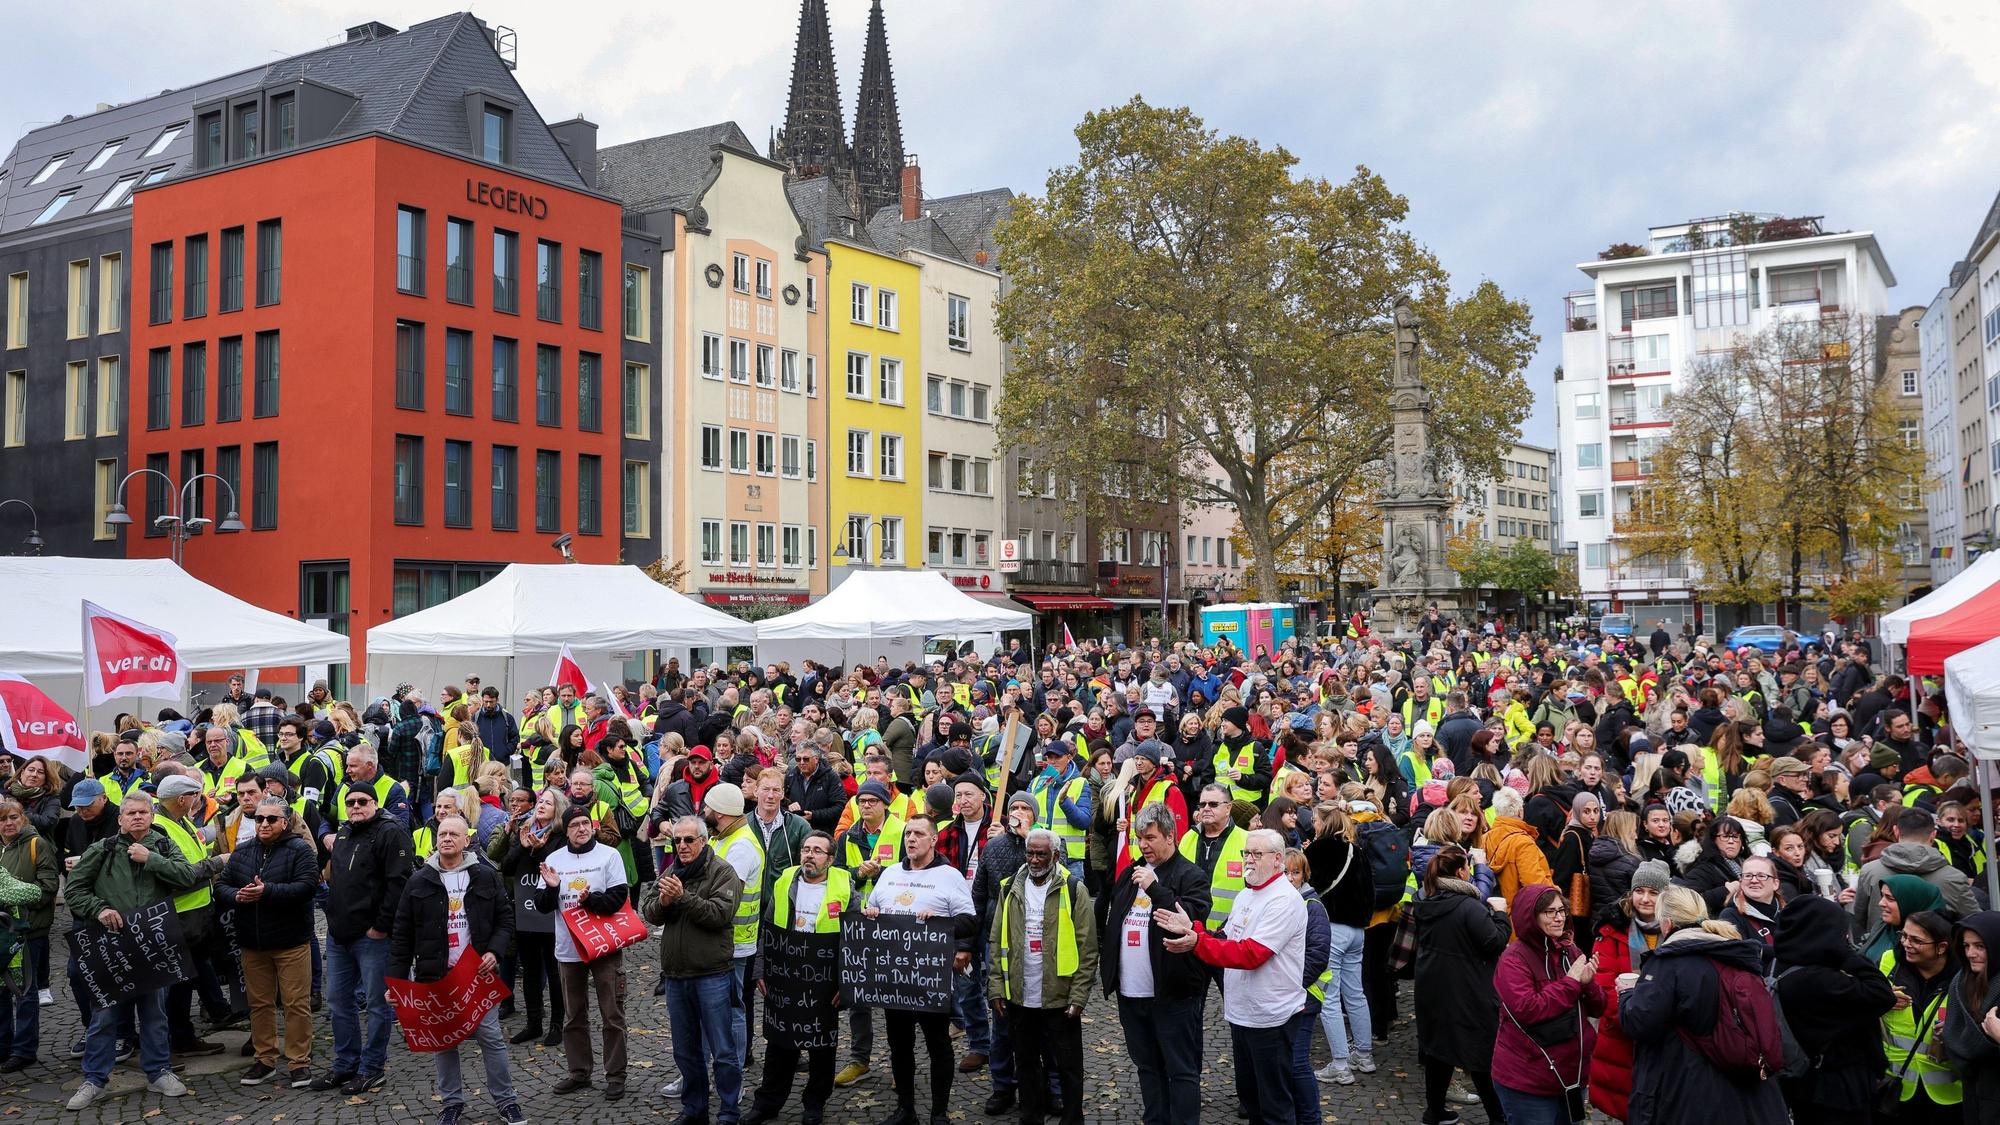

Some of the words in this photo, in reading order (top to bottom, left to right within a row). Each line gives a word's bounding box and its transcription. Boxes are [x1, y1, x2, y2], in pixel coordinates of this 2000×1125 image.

[467, 179, 548, 220] LEGEND
[709, 573, 724, 583] von
[955, 577, 977, 586] KIOSK
[106, 655, 172, 674] ver.di
[843, 920, 866, 942] Mit
[872, 922, 900, 942] dem
[902, 924, 947, 952] guten
[115, 950, 133, 971] eine
[817, 949, 834, 958] es
[841, 946, 870, 970] Ruf
[876, 948, 891, 966] ist
[894, 956, 909, 966] es
[912, 951, 947, 970] jetzt
[841, 969, 866, 985] AUS
[875, 967, 888, 983] im
[891, 968, 943, 988] DuMont
[792, 1017, 821, 1034] net
